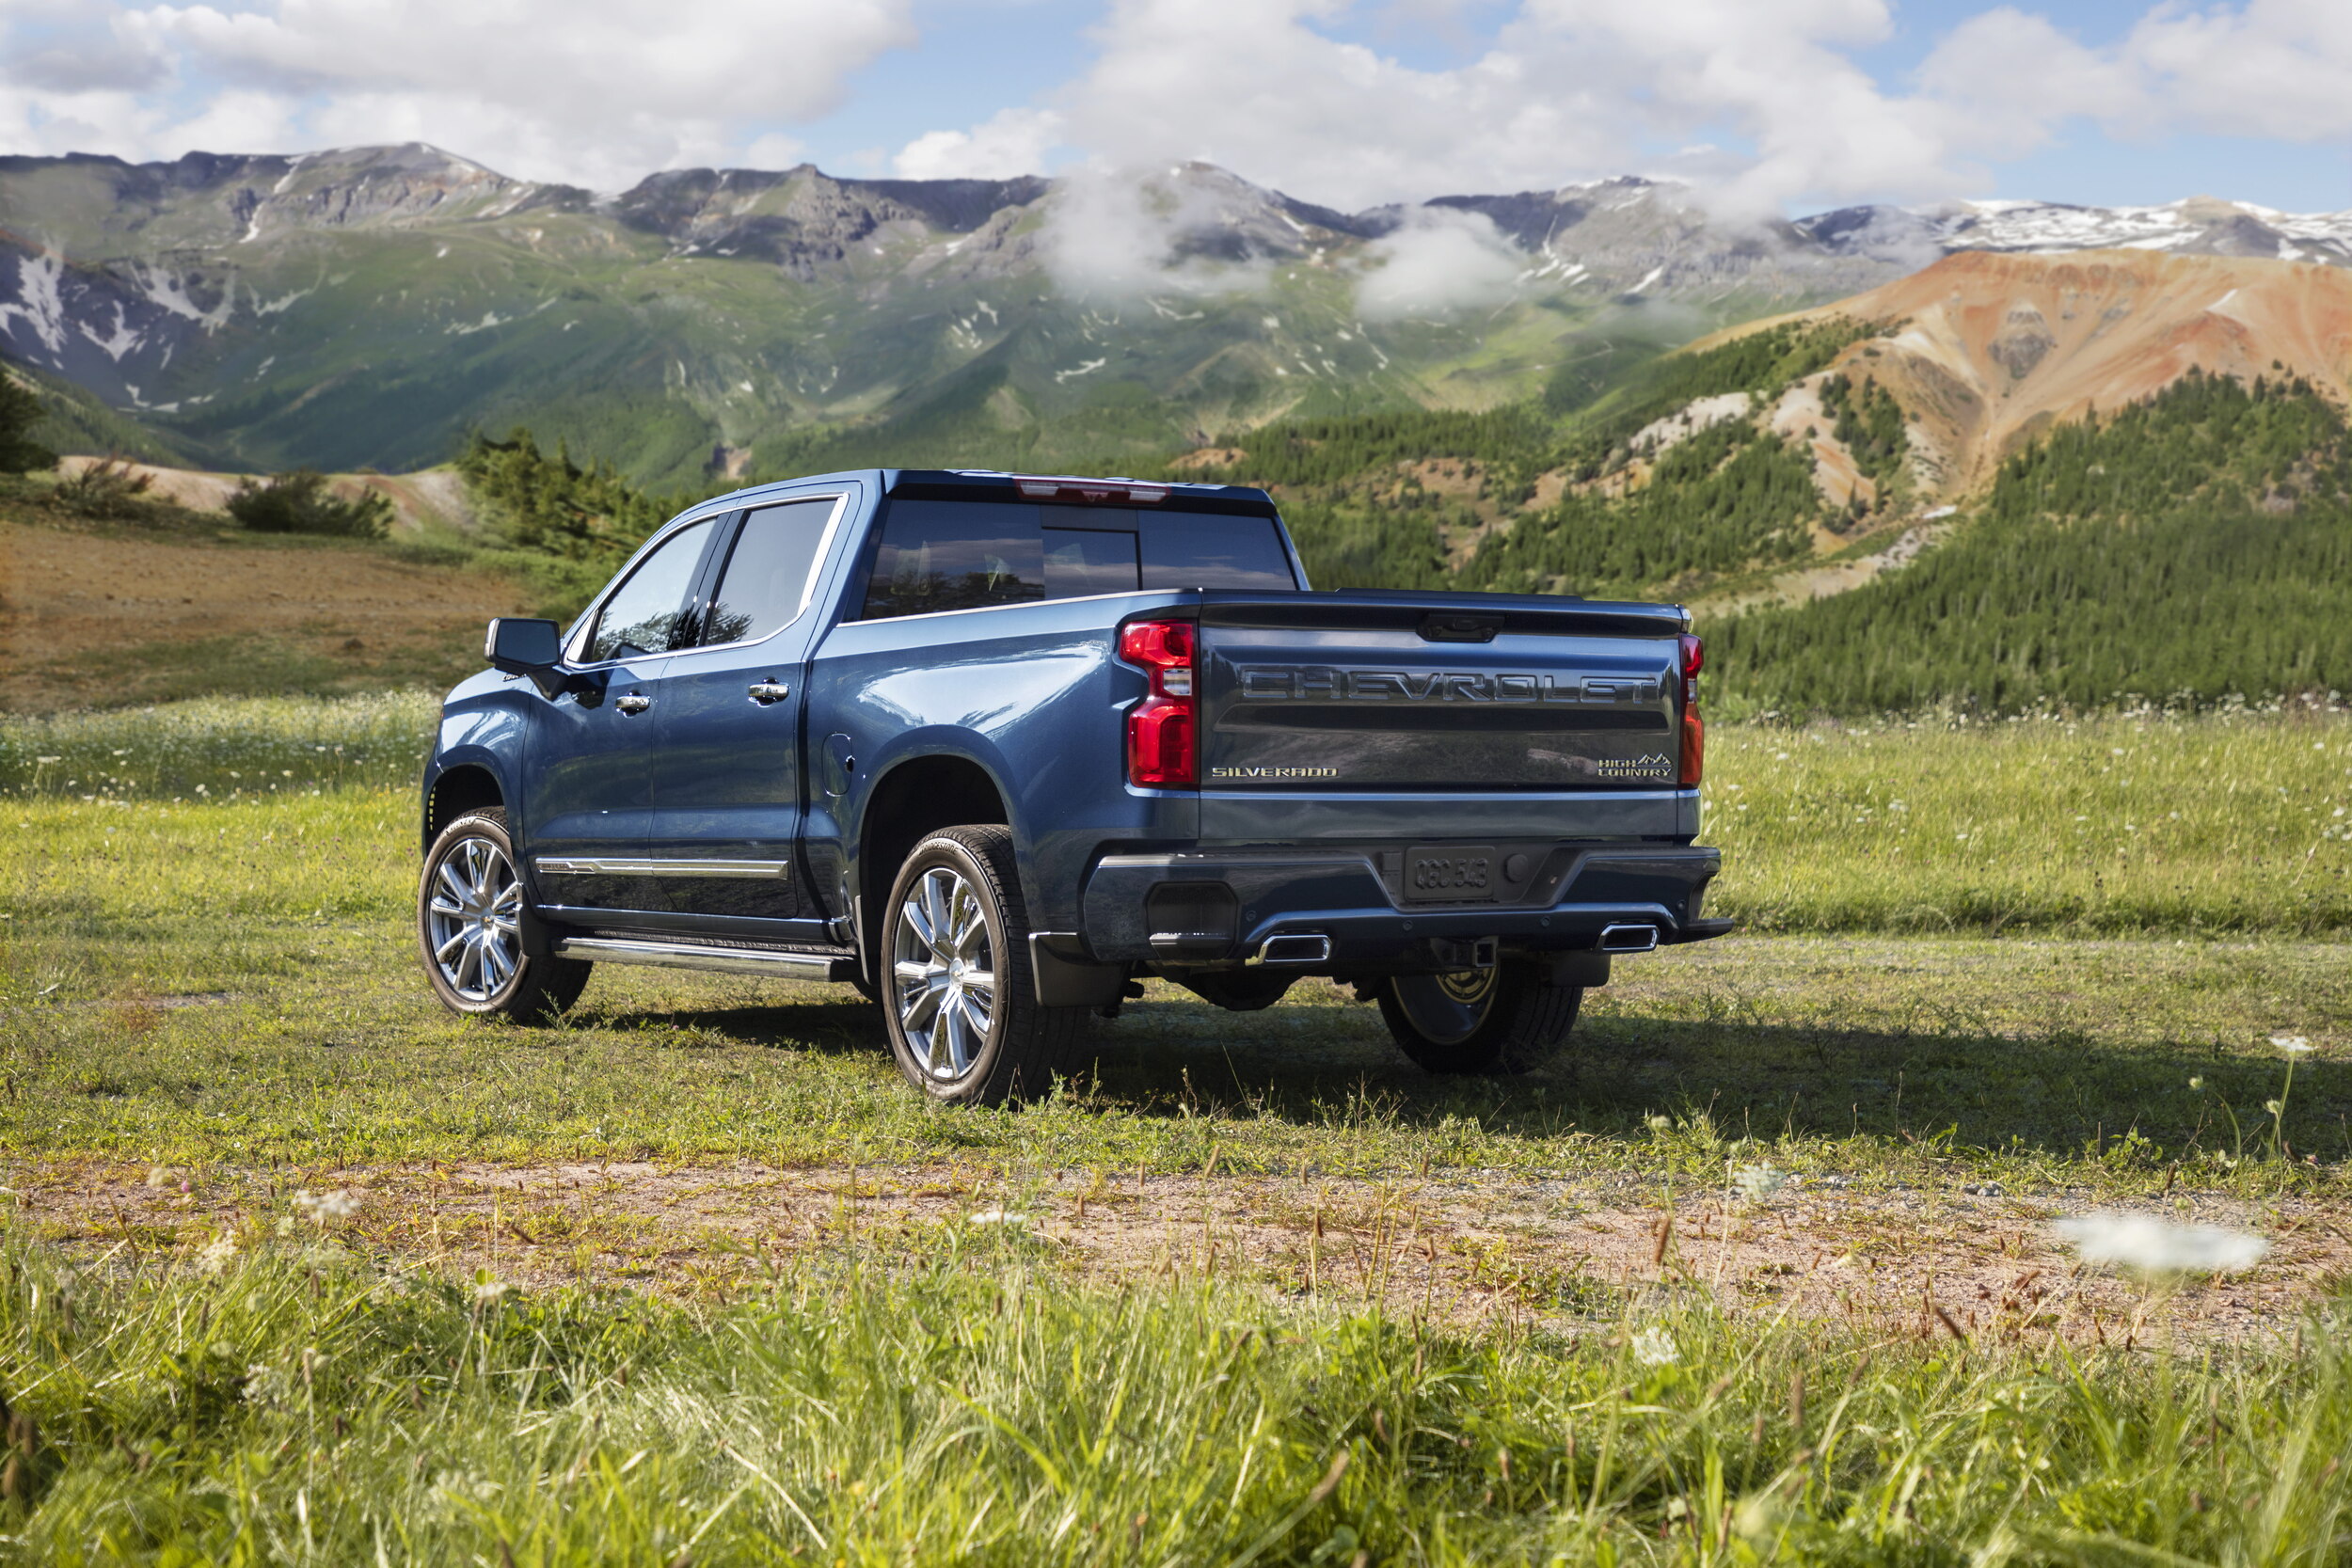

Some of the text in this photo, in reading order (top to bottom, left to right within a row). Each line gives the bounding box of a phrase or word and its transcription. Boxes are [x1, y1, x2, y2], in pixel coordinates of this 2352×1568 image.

[1243, 670, 1658, 705] CHEVROLET
[1598, 759, 1637, 768] HIGH
[1212, 768, 1338, 777] SILVERADO
[1598, 768, 1672, 777] COUNTRY
